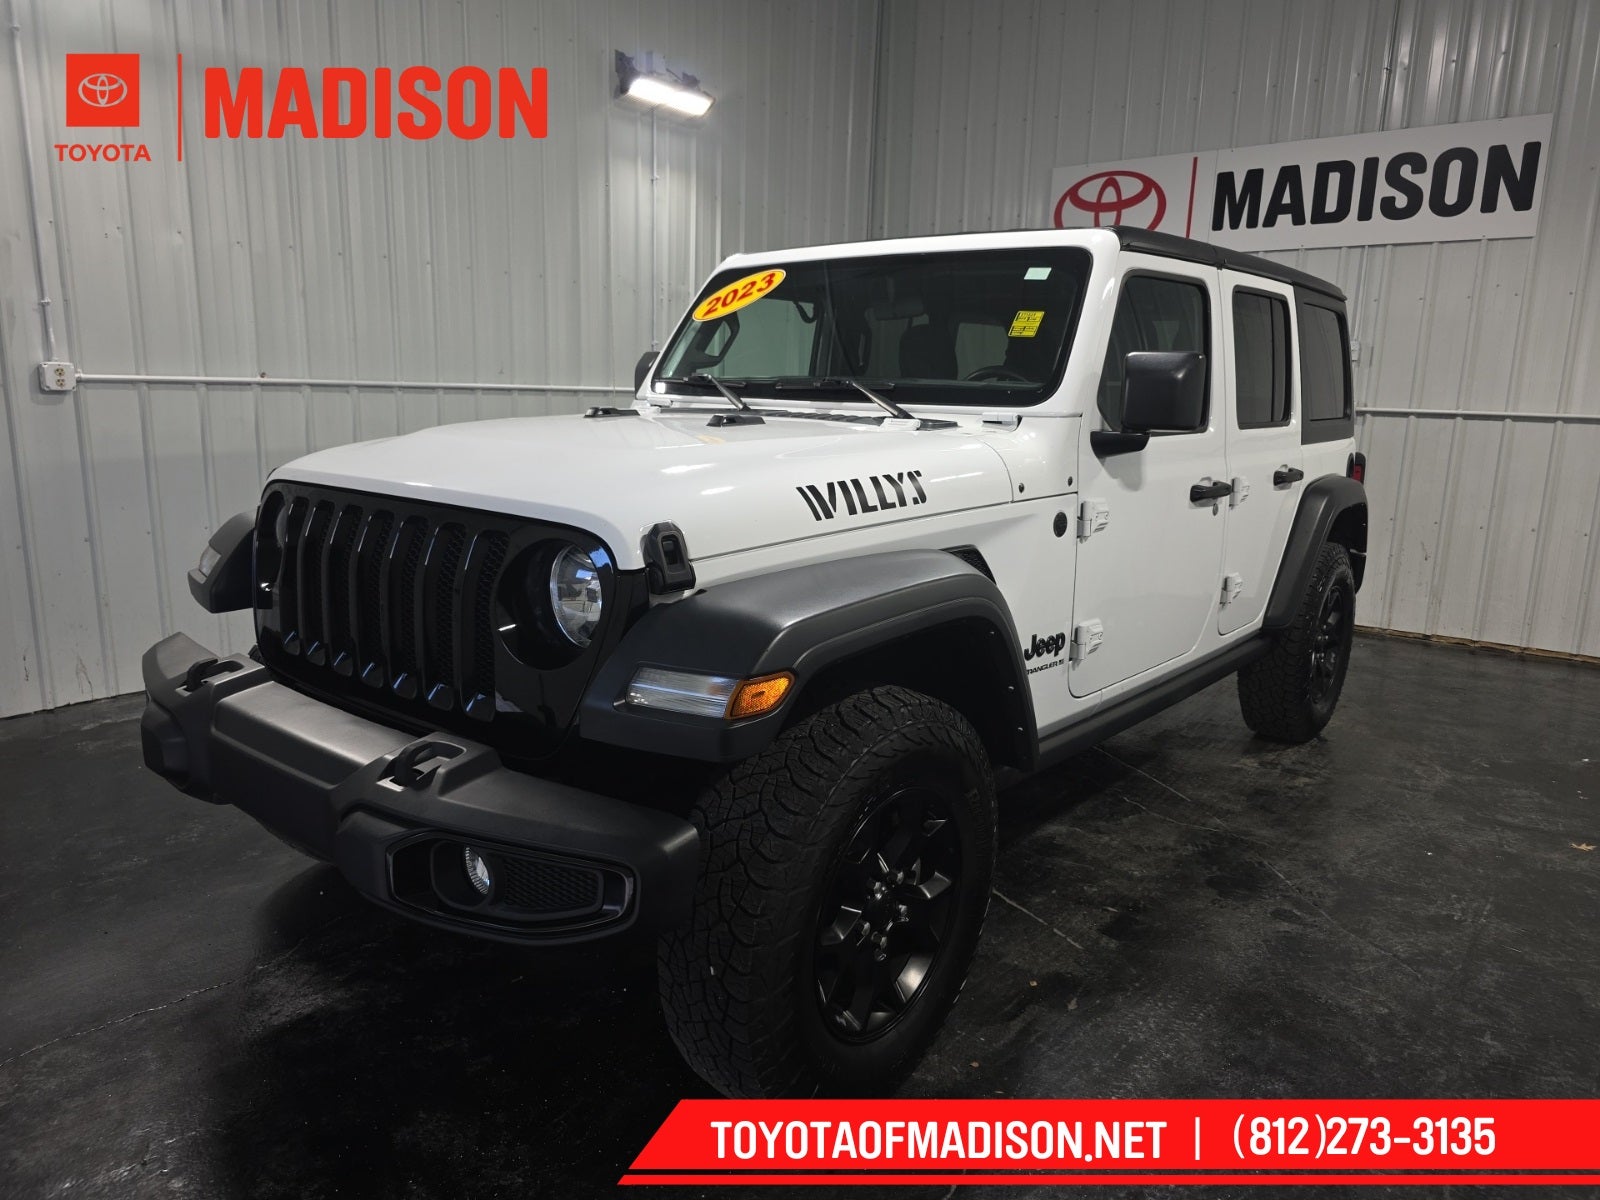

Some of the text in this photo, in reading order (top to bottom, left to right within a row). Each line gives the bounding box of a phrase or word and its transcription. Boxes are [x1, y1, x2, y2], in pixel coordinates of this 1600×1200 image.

[1212, 141, 1542, 231] MADISON
[702, 272, 776, 318] 2023
[796, 470, 927, 521] WILLYS
[1024, 632, 1066, 661] Jeep
